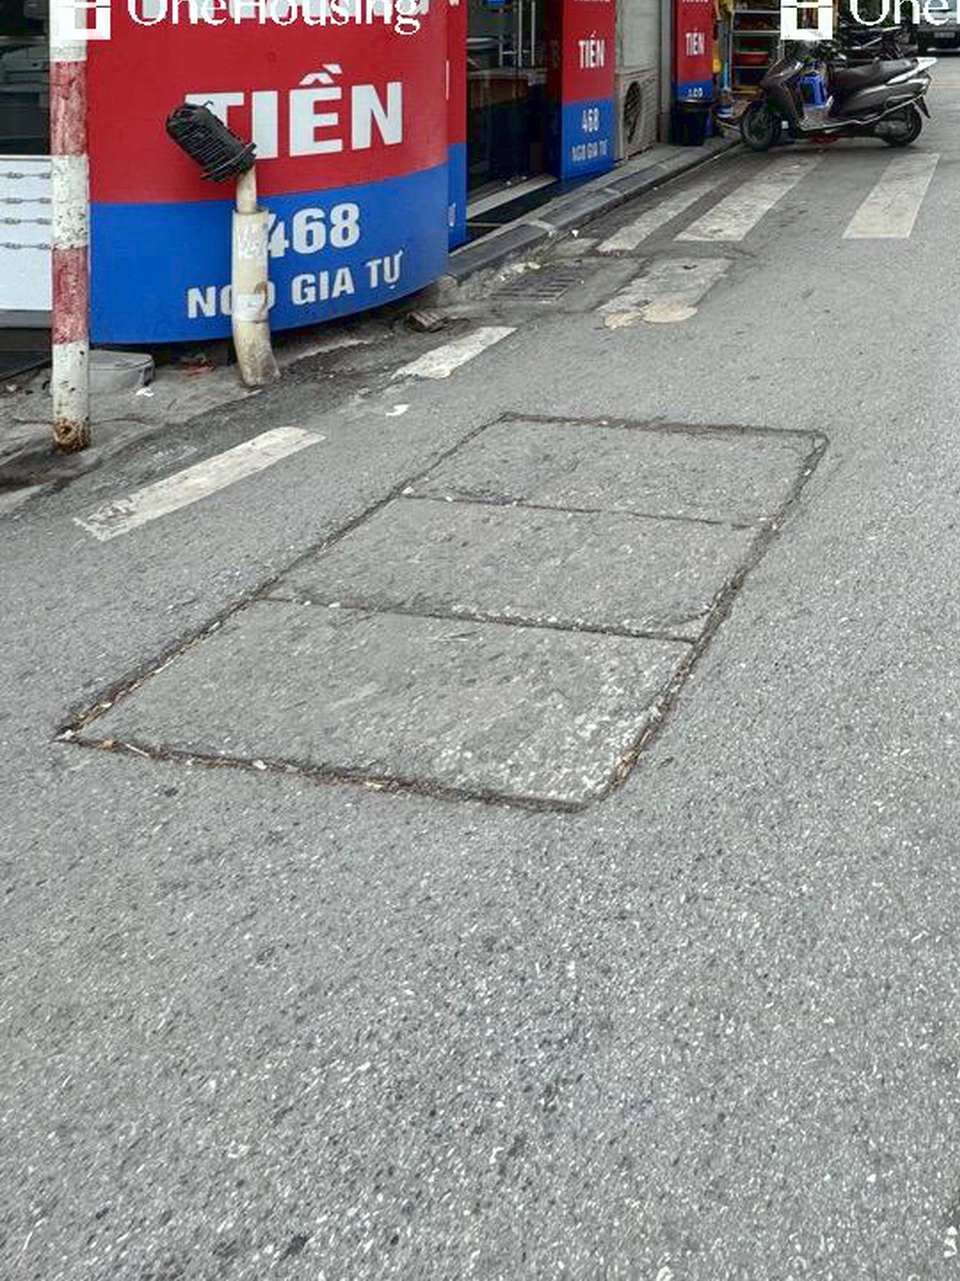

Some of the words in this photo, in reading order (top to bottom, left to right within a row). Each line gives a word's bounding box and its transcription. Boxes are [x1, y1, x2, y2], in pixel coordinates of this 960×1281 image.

[185, 63, 403, 160] TIỀN
[291, 267, 355, 306] GIA
[366, 248, 404, 289] TỰ
